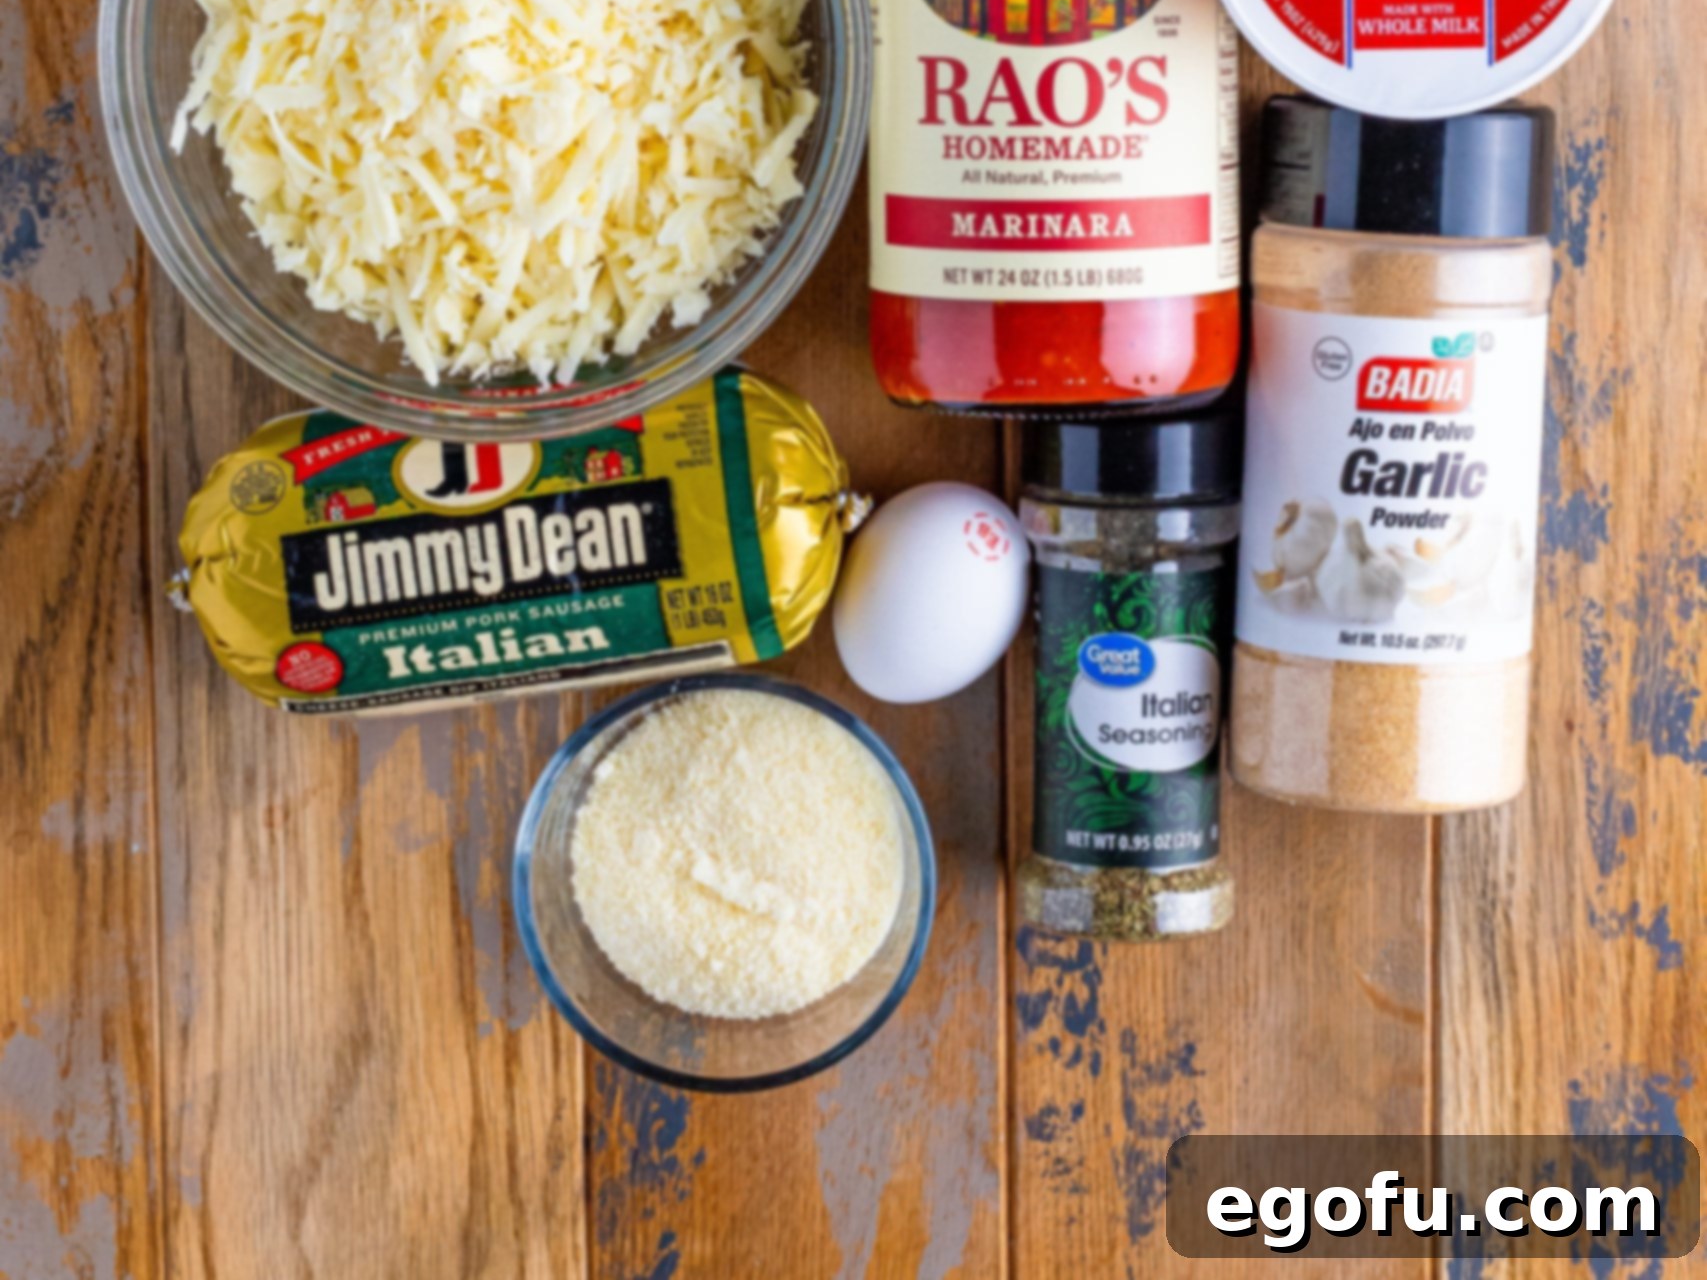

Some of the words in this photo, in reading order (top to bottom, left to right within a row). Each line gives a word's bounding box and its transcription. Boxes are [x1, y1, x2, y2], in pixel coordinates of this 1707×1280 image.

[1383, 4, 1417, 15] MADE
[1421, 3, 1454, 14] WITH
[1358, 19, 1426, 35] WHOLE
[1432, 17, 1480, 34] MILK
[1502, 24, 1532, 49] MADE
[1530, 13, 1545, 27] IN
[918, 55, 1169, 127] RAO'S
[943, 135, 1143, 161] HOMEMADE
[961, 169, 982, 184] All
[986, 169, 1048, 186] Natural,
[1053, 169, 1122, 184] Premium
[952, 212, 1134, 238] MARINARA
[943, 268, 967, 284] NET
[972, 268, 993, 284] WT
[1000, 269, 1017, 286] 24
[1020, 269, 1041, 285] OZ
[1045, 268, 1073, 288] (1.5
[1077, 268, 1102, 287] LB)
[1108, 268, 1144, 284] 680G
[1365, 366, 1465, 401] BADIA
[1348, 418, 1384, 442] Ajo
[1389, 423, 1416, 440] en
[1421, 421, 1474, 441] Polvo
[303, 430, 372, 465] FRESH
[1339, 448, 1488, 498] Garlic
[1371, 508, 1449, 529] Powder
[314, 523, 504, 611] Jimmy
[504, 502, 647, 582] Dean
[667, 587, 684, 609] NET
[358, 619, 458, 645] PREMIUM
[465, 611, 521, 628] PORK
[528, 595, 626, 620] SAUSAGE
[1339, 630, 1358, 645] Net
[383, 624, 610, 679] Italian
[1086, 644, 1141, 663] Great
[1101, 662, 1141, 674] Value
[1141, 693, 1212, 718] Italian
[1066, 830, 1089, 846] NET
[1094, 833, 1115, 850] WT
[1118, 834, 1149, 851] 0.95
[1153, 833, 1170, 850] OZ
